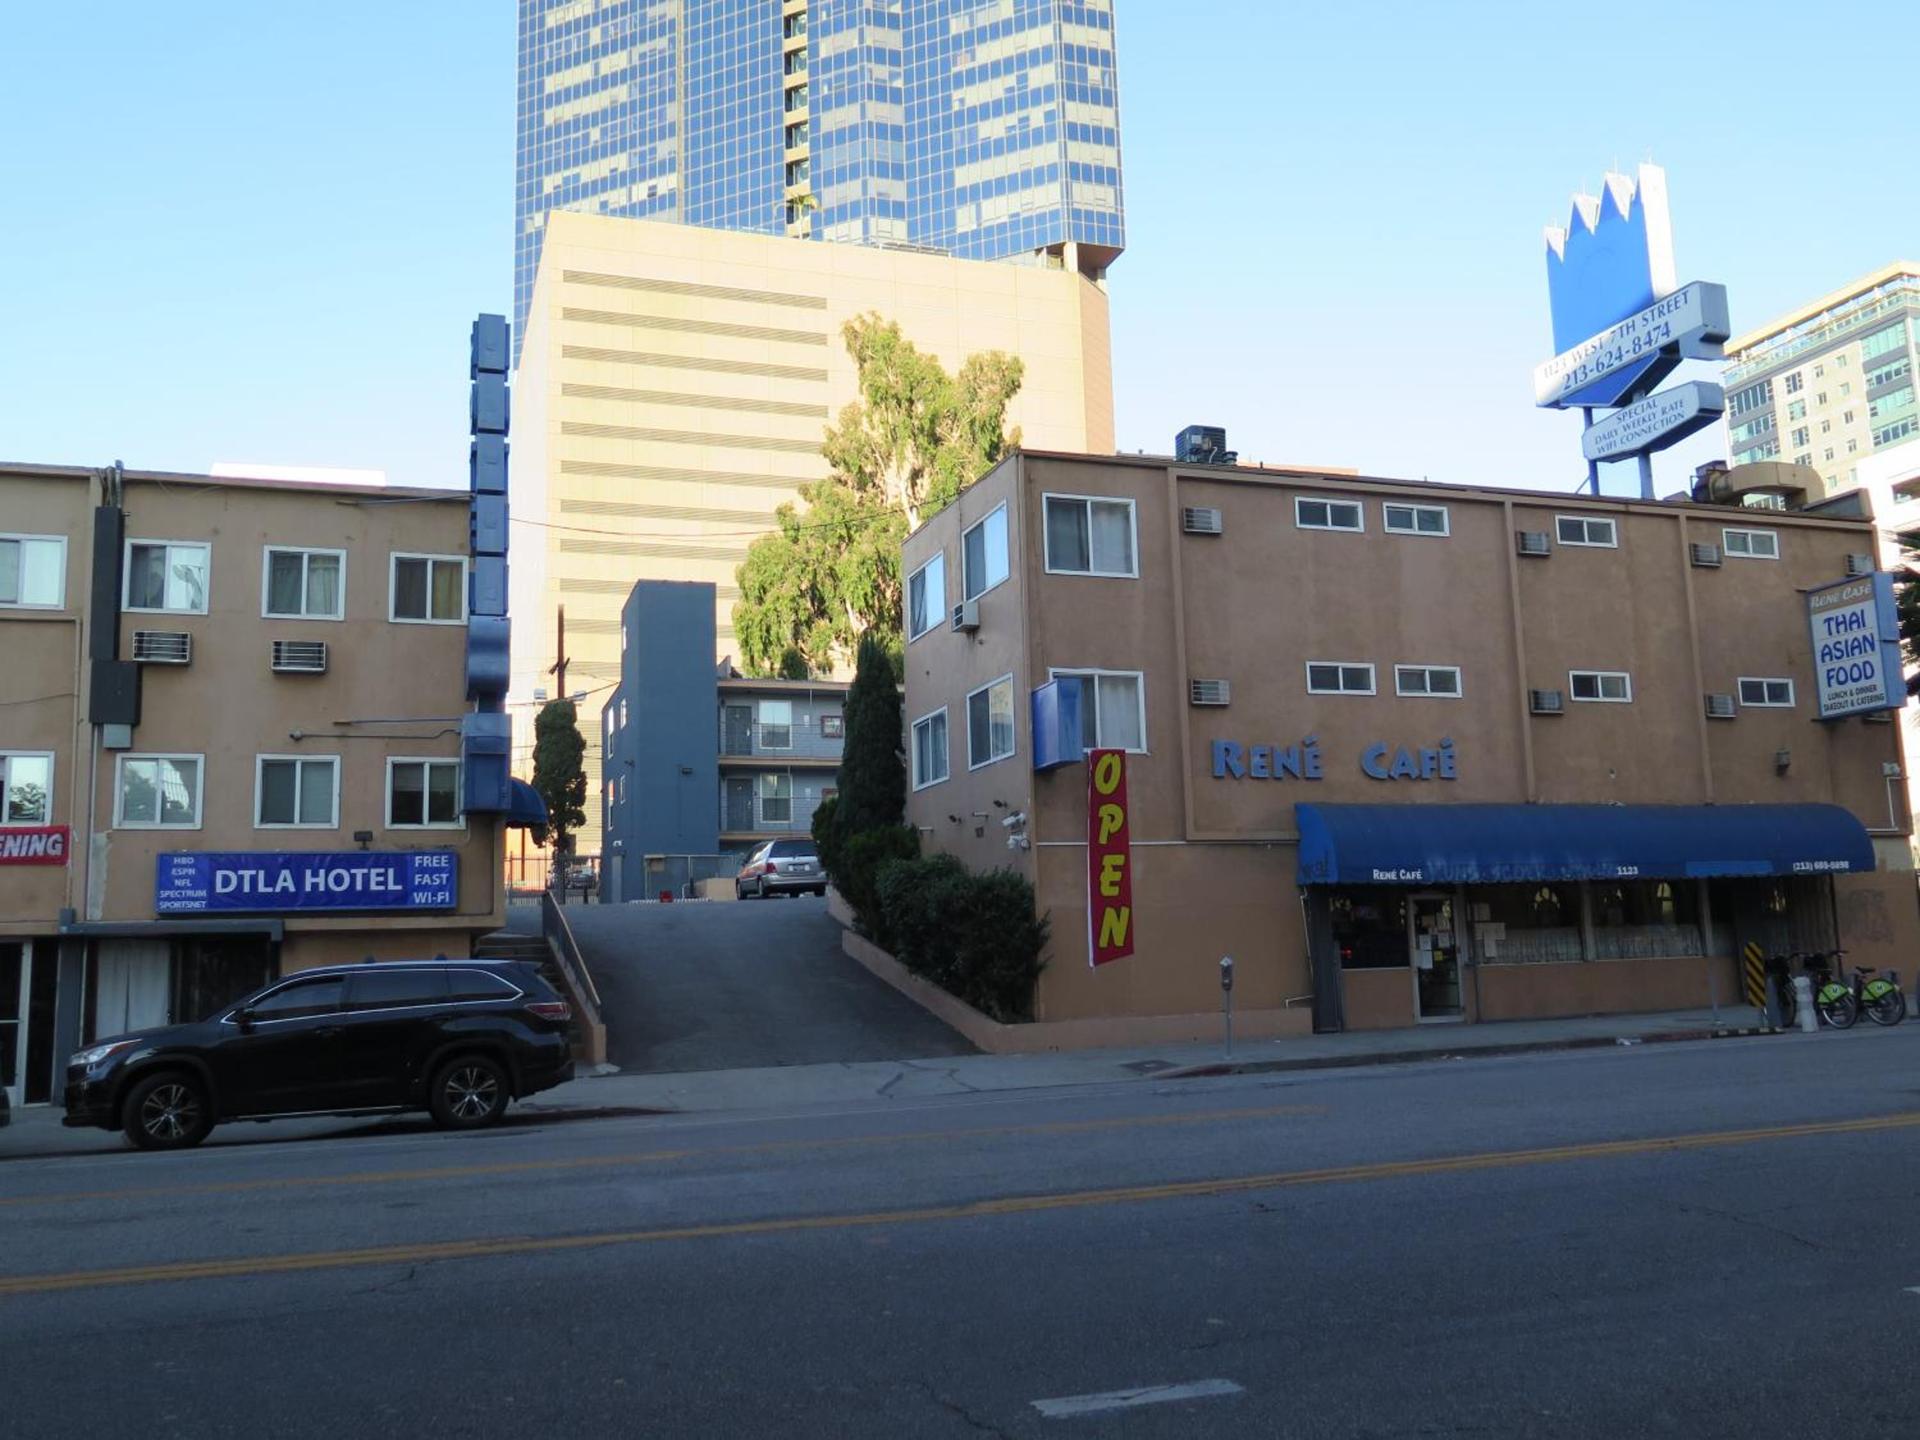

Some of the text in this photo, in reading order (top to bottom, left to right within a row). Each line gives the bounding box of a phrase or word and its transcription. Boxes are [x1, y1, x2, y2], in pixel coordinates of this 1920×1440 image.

[1572, 339, 1603, 363] WEST
[1610, 320, 1636, 343] 7TH
[1641, 290, 1690, 327] STREET
[1562, 321, 1671, 391] 213-624-8474
[1616, 398, 1658, 423] SPECIAL
[1595, 399, 1684, 445] DAILY WEEKLY RATE
[1620, 411, 1686, 446] CONNECTION
[1823, 608, 1866, 636] THAI
[1821, 632, 1876, 664] ASIAN
[1826, 660, 1875, 688] FOOD
[1827, 690, 1848, 701] LUNCH
[1856, 684, 1877, 696] DINNER
[1857, 692, 1885, 706] CATERING
[1094, 752, 1130, 948] OPEN
[173, 856, 195, 865] HBO
[414, 855, 449, 867] FREE
[171, 867, 196, 876] ESPN
[414, 873, 449, 885] FAST
[1616, 865, 1639, 876] 1123
[174, 878, 193, 887] NFL
[215, 868, 403, 893] DTLA HOTEL
[159, 889, 207, 898] SPECTRUM
[413, 891, 450, 904] WI-FI
[159, 900, 207, 909] SPORTSNET
